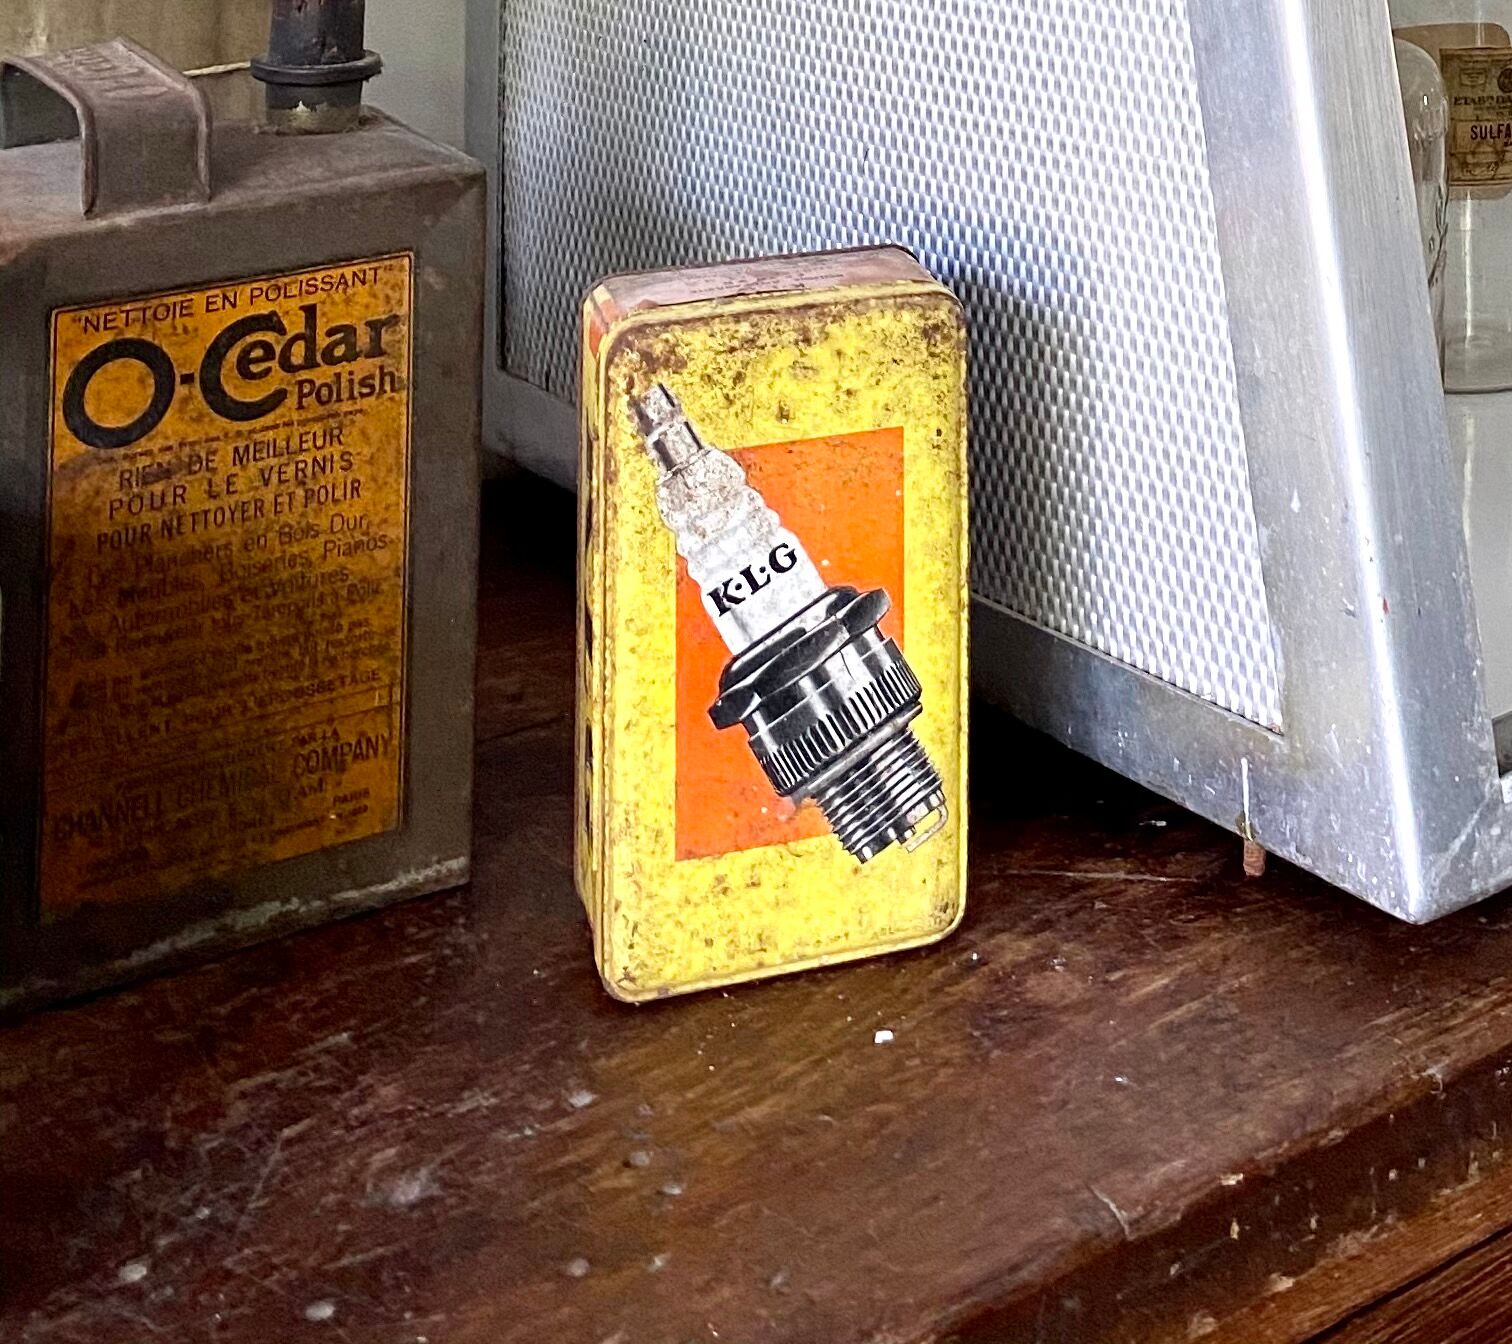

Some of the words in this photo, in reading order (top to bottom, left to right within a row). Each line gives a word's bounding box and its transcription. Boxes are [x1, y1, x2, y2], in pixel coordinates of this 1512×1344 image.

[205, 291, 238, 313] EN
[295, 364, 398, 410] Polish
[187, 448, 219, 476] DE
[232, 426, 345, 468] MEILLEUR
[108, 485, 187, 520] POUR
[208, 473, 239, 500] LE
[260, 451, 355, 489] VERNIS
[96, 523, 153, 555] POUR
[161, 498, 266, 539] NETTOYER
[273, 491, 296, 518] ET
[303, 477, 364, 510] POLIR
[243, 532, 269, 555] en
[293, 730, 391, 779] COMPANY
